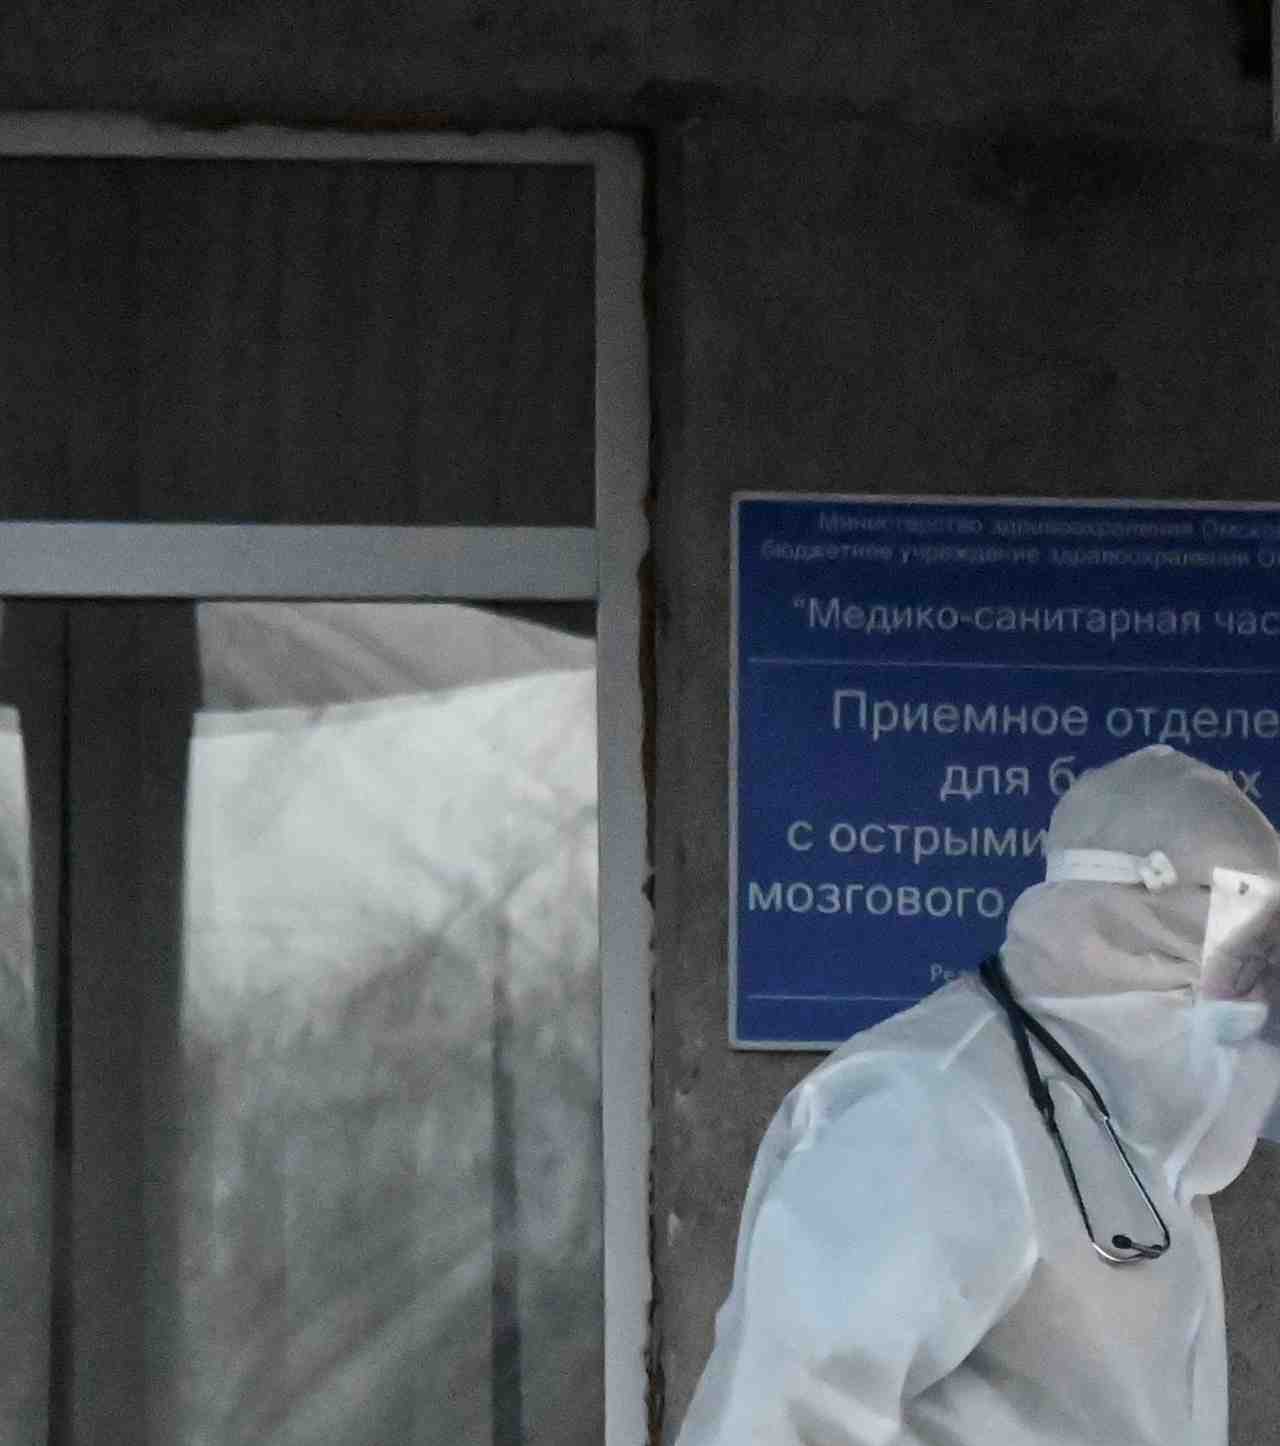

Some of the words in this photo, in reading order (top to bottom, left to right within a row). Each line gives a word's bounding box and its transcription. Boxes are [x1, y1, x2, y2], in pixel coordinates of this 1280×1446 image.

[832, 689, 1089, 741] Приемное
[940, 764, 1029, 801] для
[786, 820, 813, 851] с
[828, 823, 1045, 864] острыми
[748, 880, 1005, 918] мозгового
